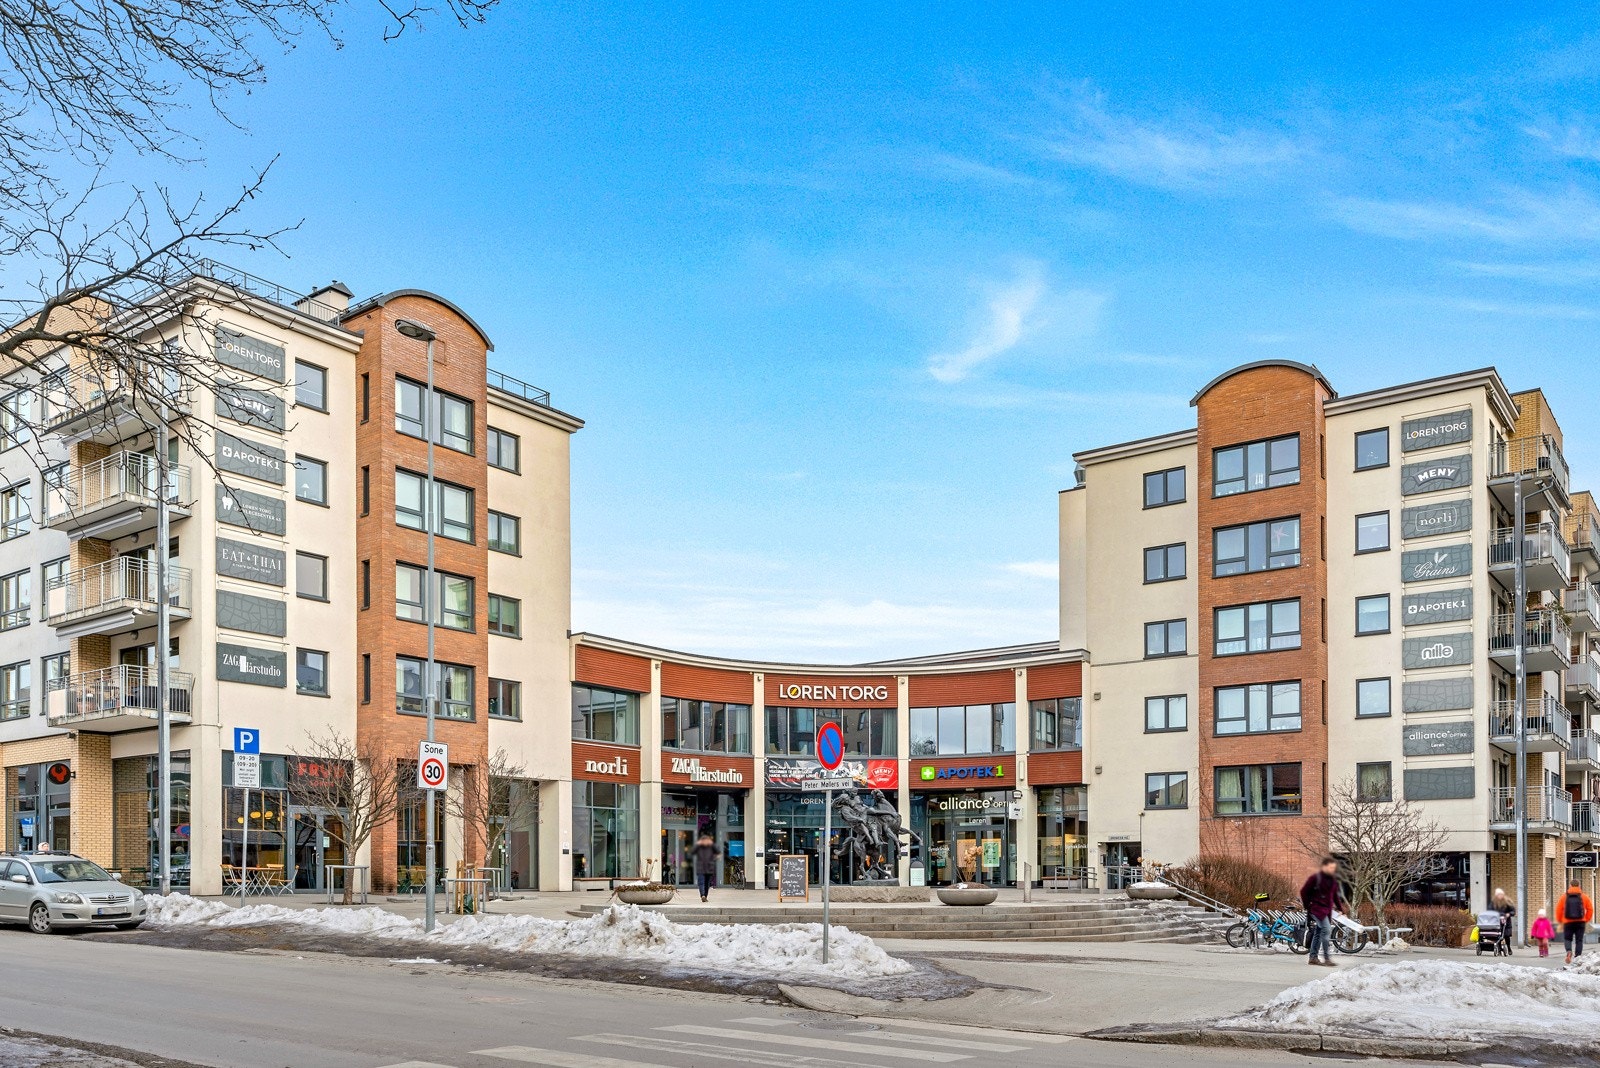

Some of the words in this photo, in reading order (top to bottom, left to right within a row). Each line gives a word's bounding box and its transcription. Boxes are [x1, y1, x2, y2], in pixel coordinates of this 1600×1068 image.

[254, 351, 281, 368] TORG
[233, 397, 270, 415] MENY
[1440, 421, 1467, 434] TORG
[233, 450, 274, 468] APOTEK
[274, 461, 281, 470] 1
[1418, 468, 1455, 482] MENY
[1420, 513, 1452, 526] norli
[222, 548, 245, 563] EAT
[252, 554, 281, 571] THAI
[1413, 561, 1457, 578] Grains
[1418, 601, 1459, 613] APOTEK
[1460, 600, 1467, 608] 1
[1422, 643, 1454, 660] nille
[839, 685, 888, 700] TORG
[240, 731, 254, 751] P
[1409, 731, 1448, 740] alliance
[424, 744, 444, 755] Sone
[426, 765, 441, 779] 30
[584, 756, 629, 776] norli
[671, 757, 696, 774] ZAGA
[874, 767, 892, 775] MENY
[936, 765, 995, 779] APOTEK
[995, 765, 1005, 777] 1
[939, 797, 990, 810] alliance
[992, 800, 1017, 808] OPTI
